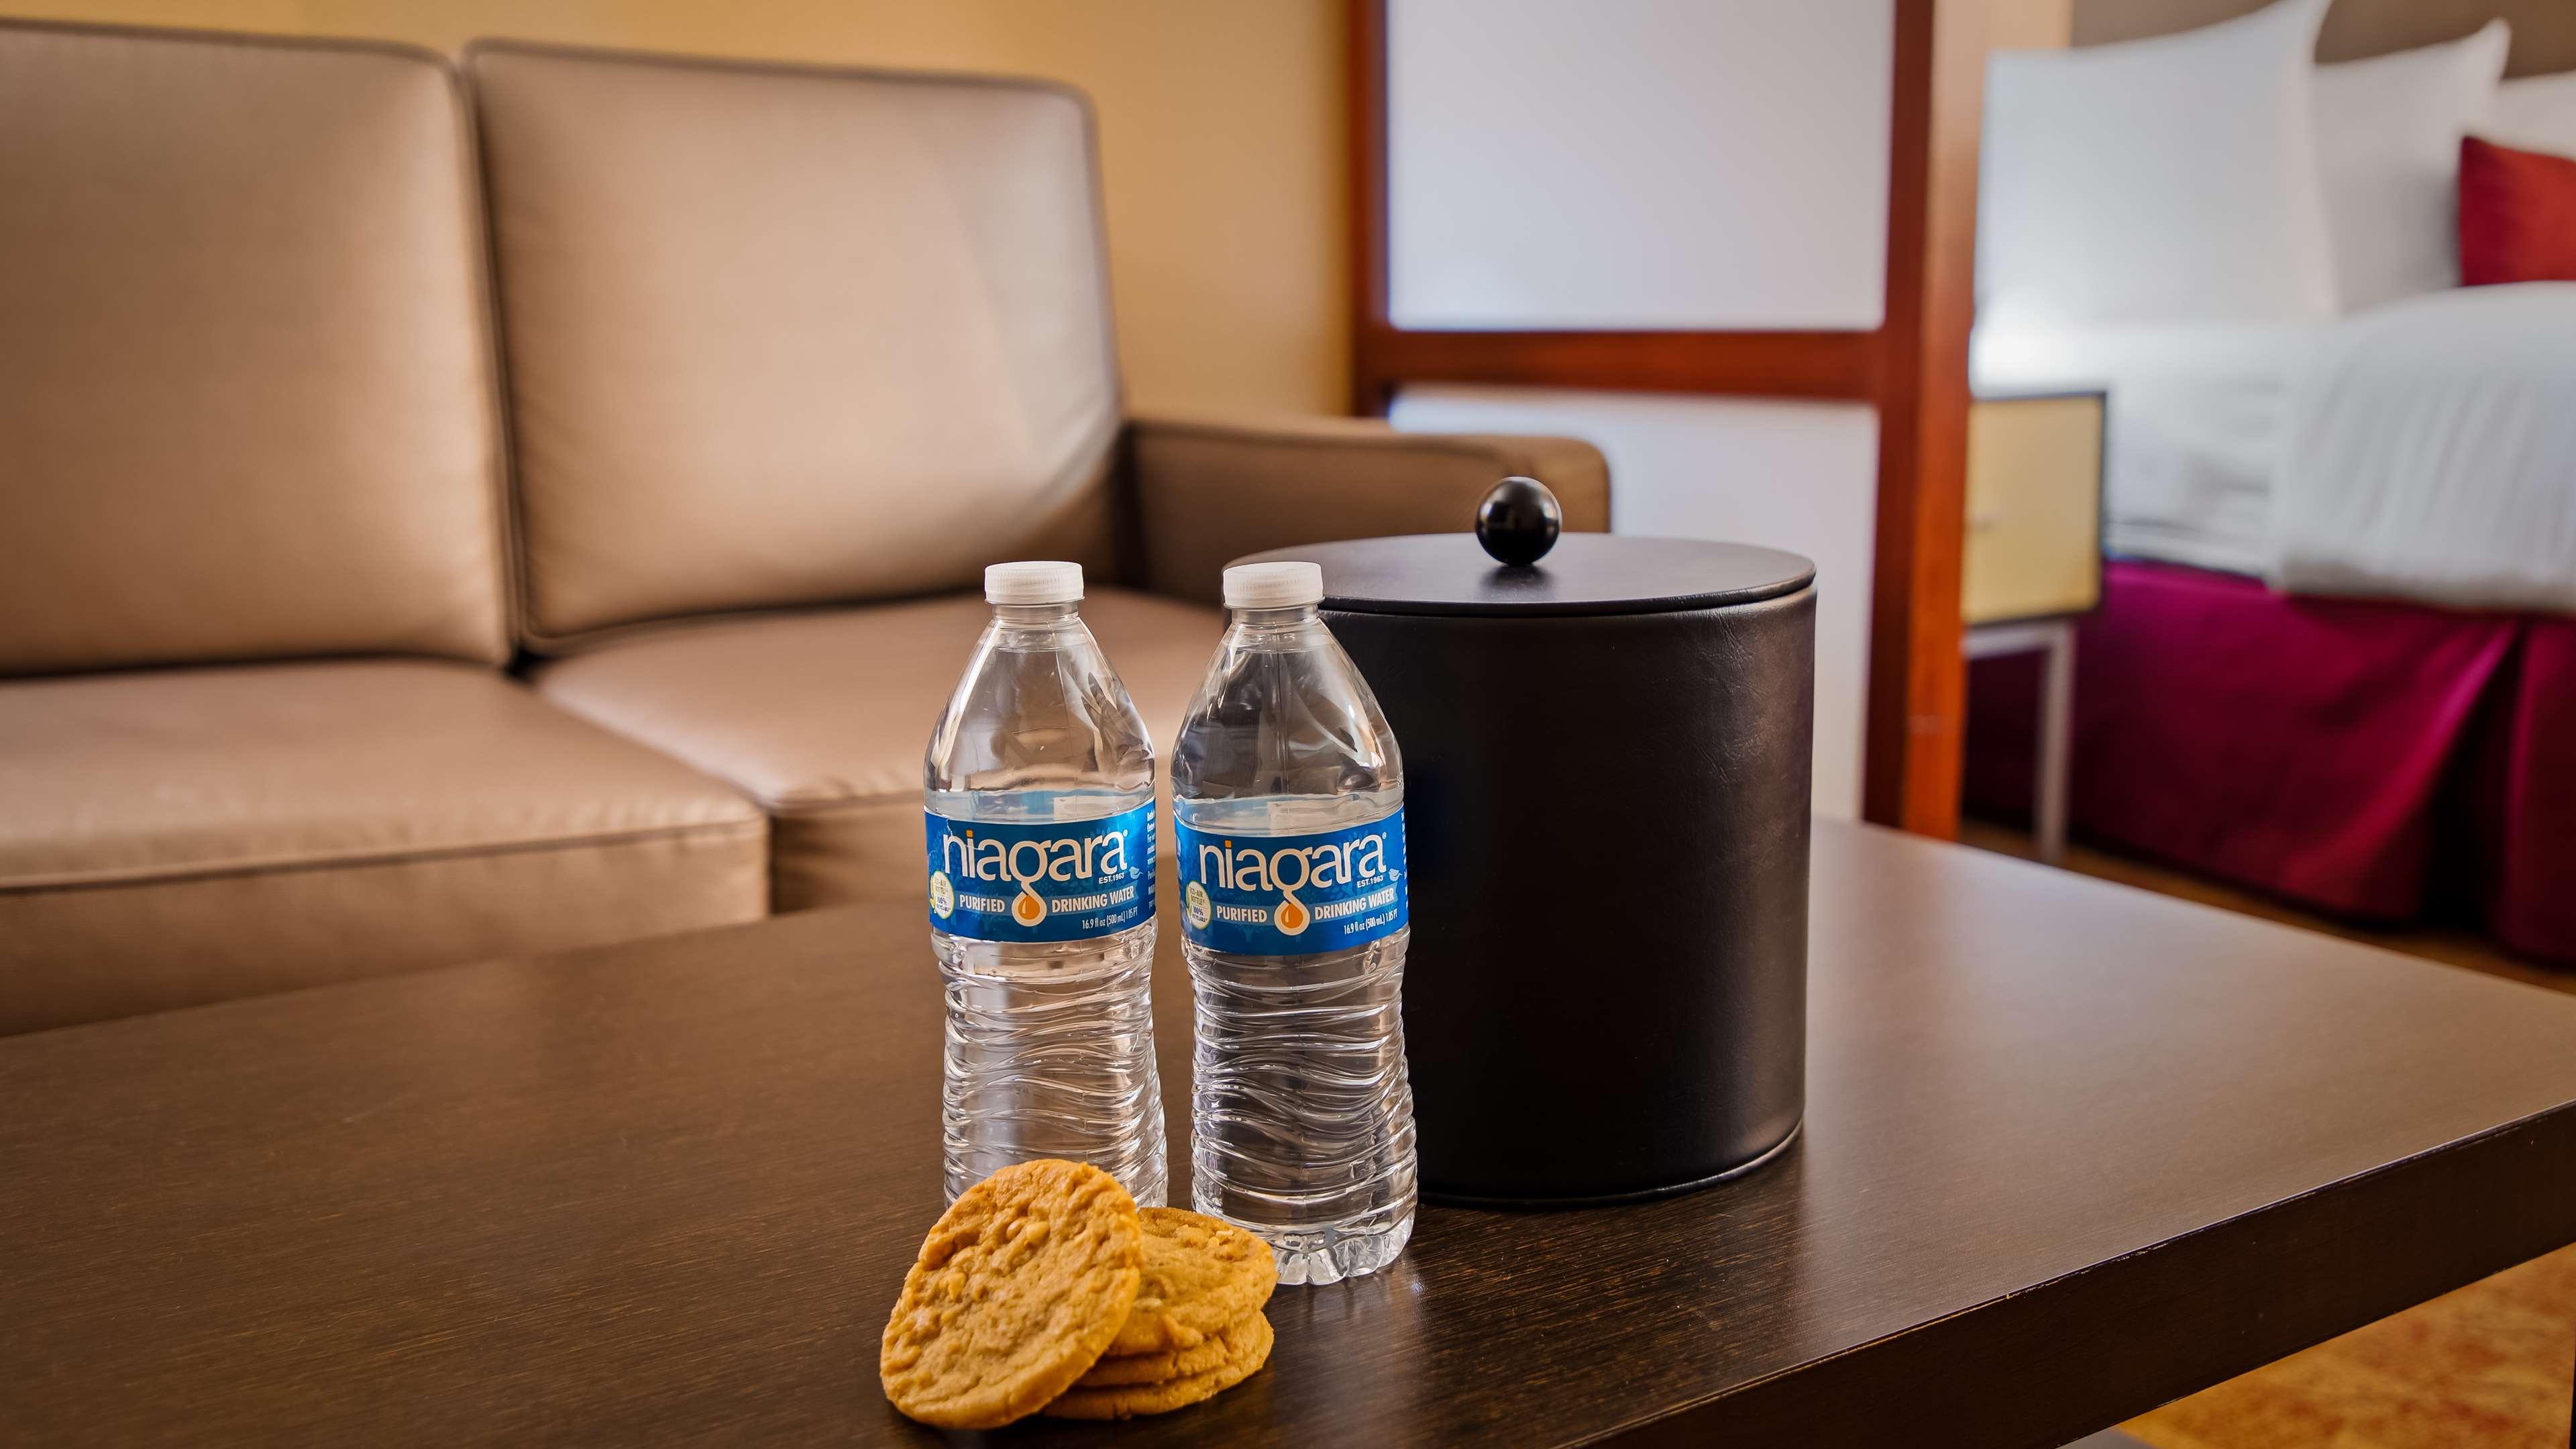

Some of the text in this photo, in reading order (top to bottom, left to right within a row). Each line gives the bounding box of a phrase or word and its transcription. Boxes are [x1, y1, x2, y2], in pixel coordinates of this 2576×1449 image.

[1099, 872, 1125, 884] EST.1963
[1357, 875, 1384, 888] EST.1963
[959, 894, 1006, 913] PURIFIED
[1052, 892, 1108, 913] DRINKING
[1109, 885, 1134, 905] WATER
[1216, 888, 1394, 924] PURIFIED DRINKING WATER
[1082, 918, 1094, 929] 16.9
[1107, 914, 1117, 927] (500
[1118, 910, 1126, 922] mL)
[1344, 922, 1354, 934] 16.9
[1359, 922, 1365, 931] oz
[1366, 916, 1376, 931] (500
[1376, 913, 1385, 926] mL)
